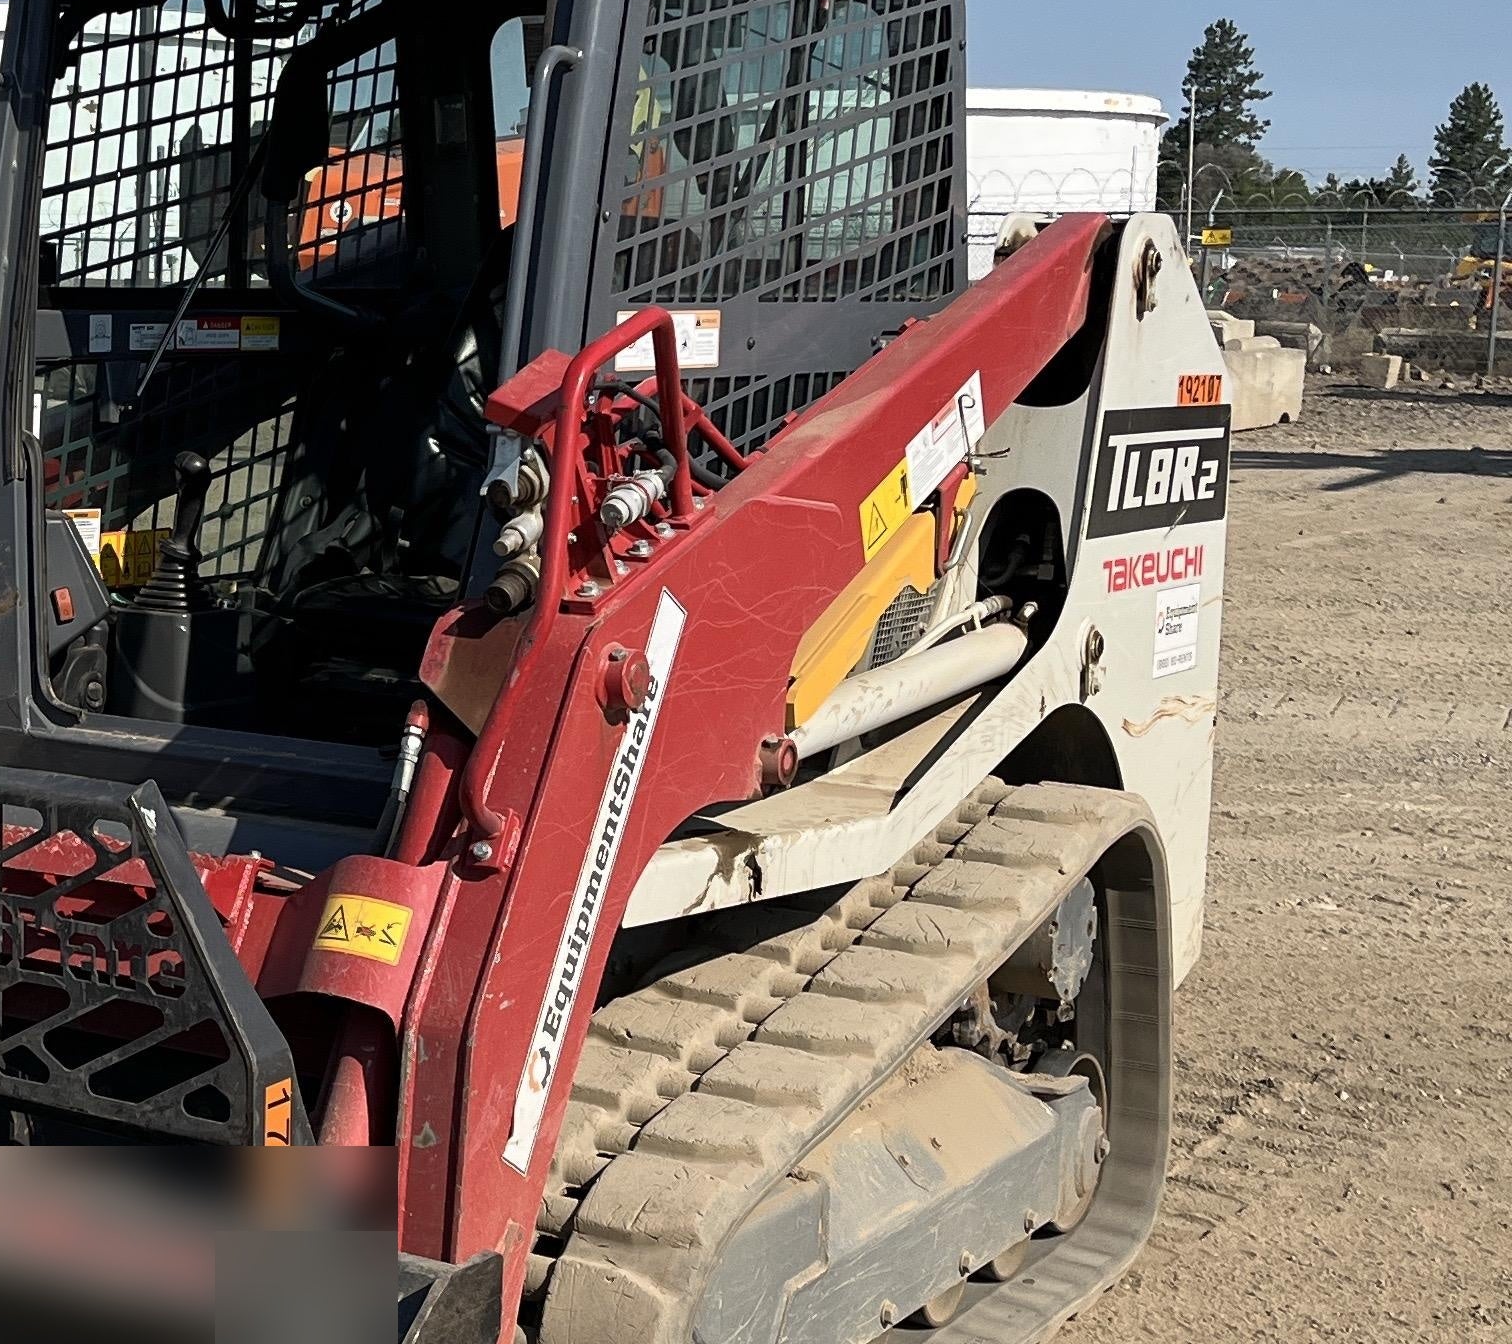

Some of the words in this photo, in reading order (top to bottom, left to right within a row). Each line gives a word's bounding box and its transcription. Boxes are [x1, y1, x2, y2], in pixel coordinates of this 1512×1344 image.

[1178, 374, 1223, 405] 192107
[1106, 426, 1226, 513] TL8R2
[1102, 544, 1206, 594] TAKEUCHI
[542, 674, 659, 1043] EquipmentShare
